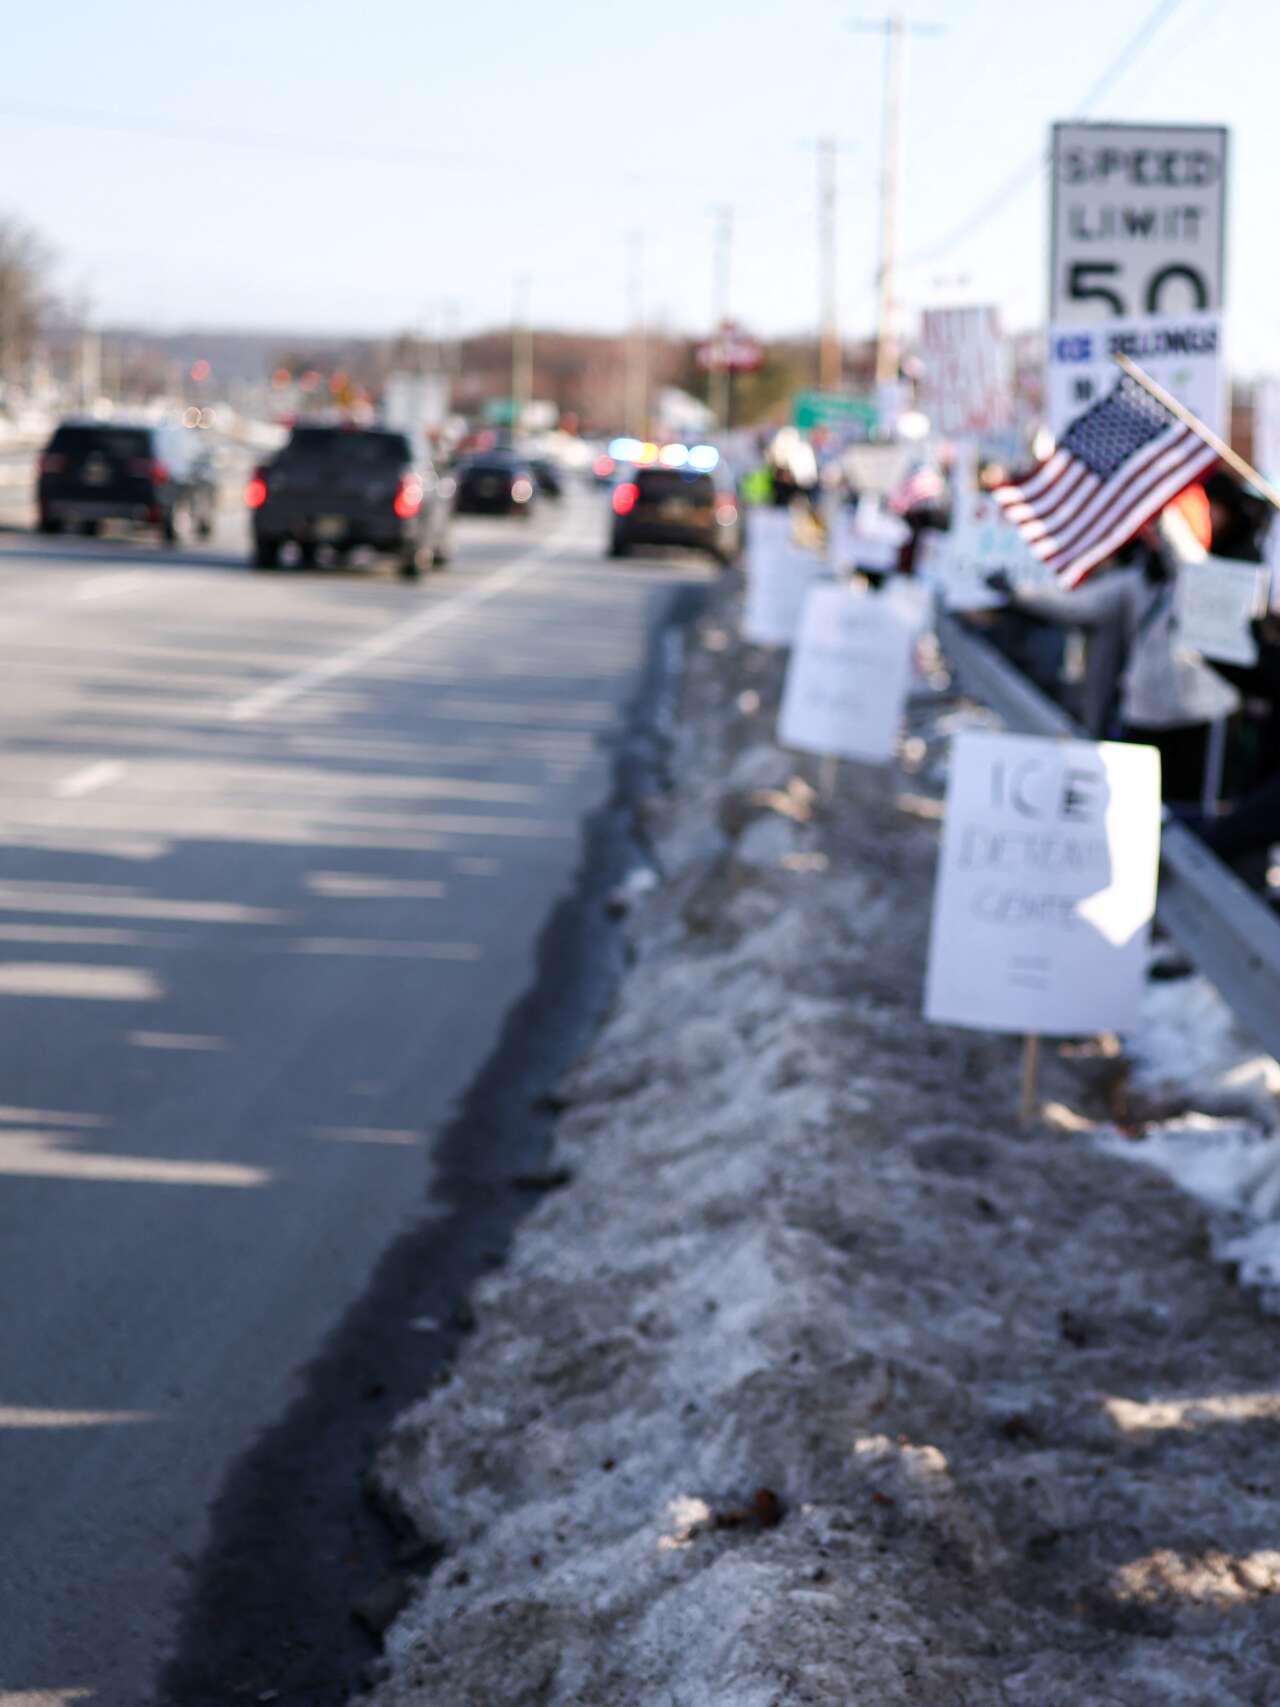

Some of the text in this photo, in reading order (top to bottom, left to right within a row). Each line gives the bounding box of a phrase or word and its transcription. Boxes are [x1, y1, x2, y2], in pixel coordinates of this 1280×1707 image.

[1061, 146, 1217, 189] SPEED
[1067, 204, 1203, 244] LIMIT
[1066, 261, 1210, 317] 50
[1107, 325, 1218, 356] BELONGS
[990, 758, 1098, 824] ICE
